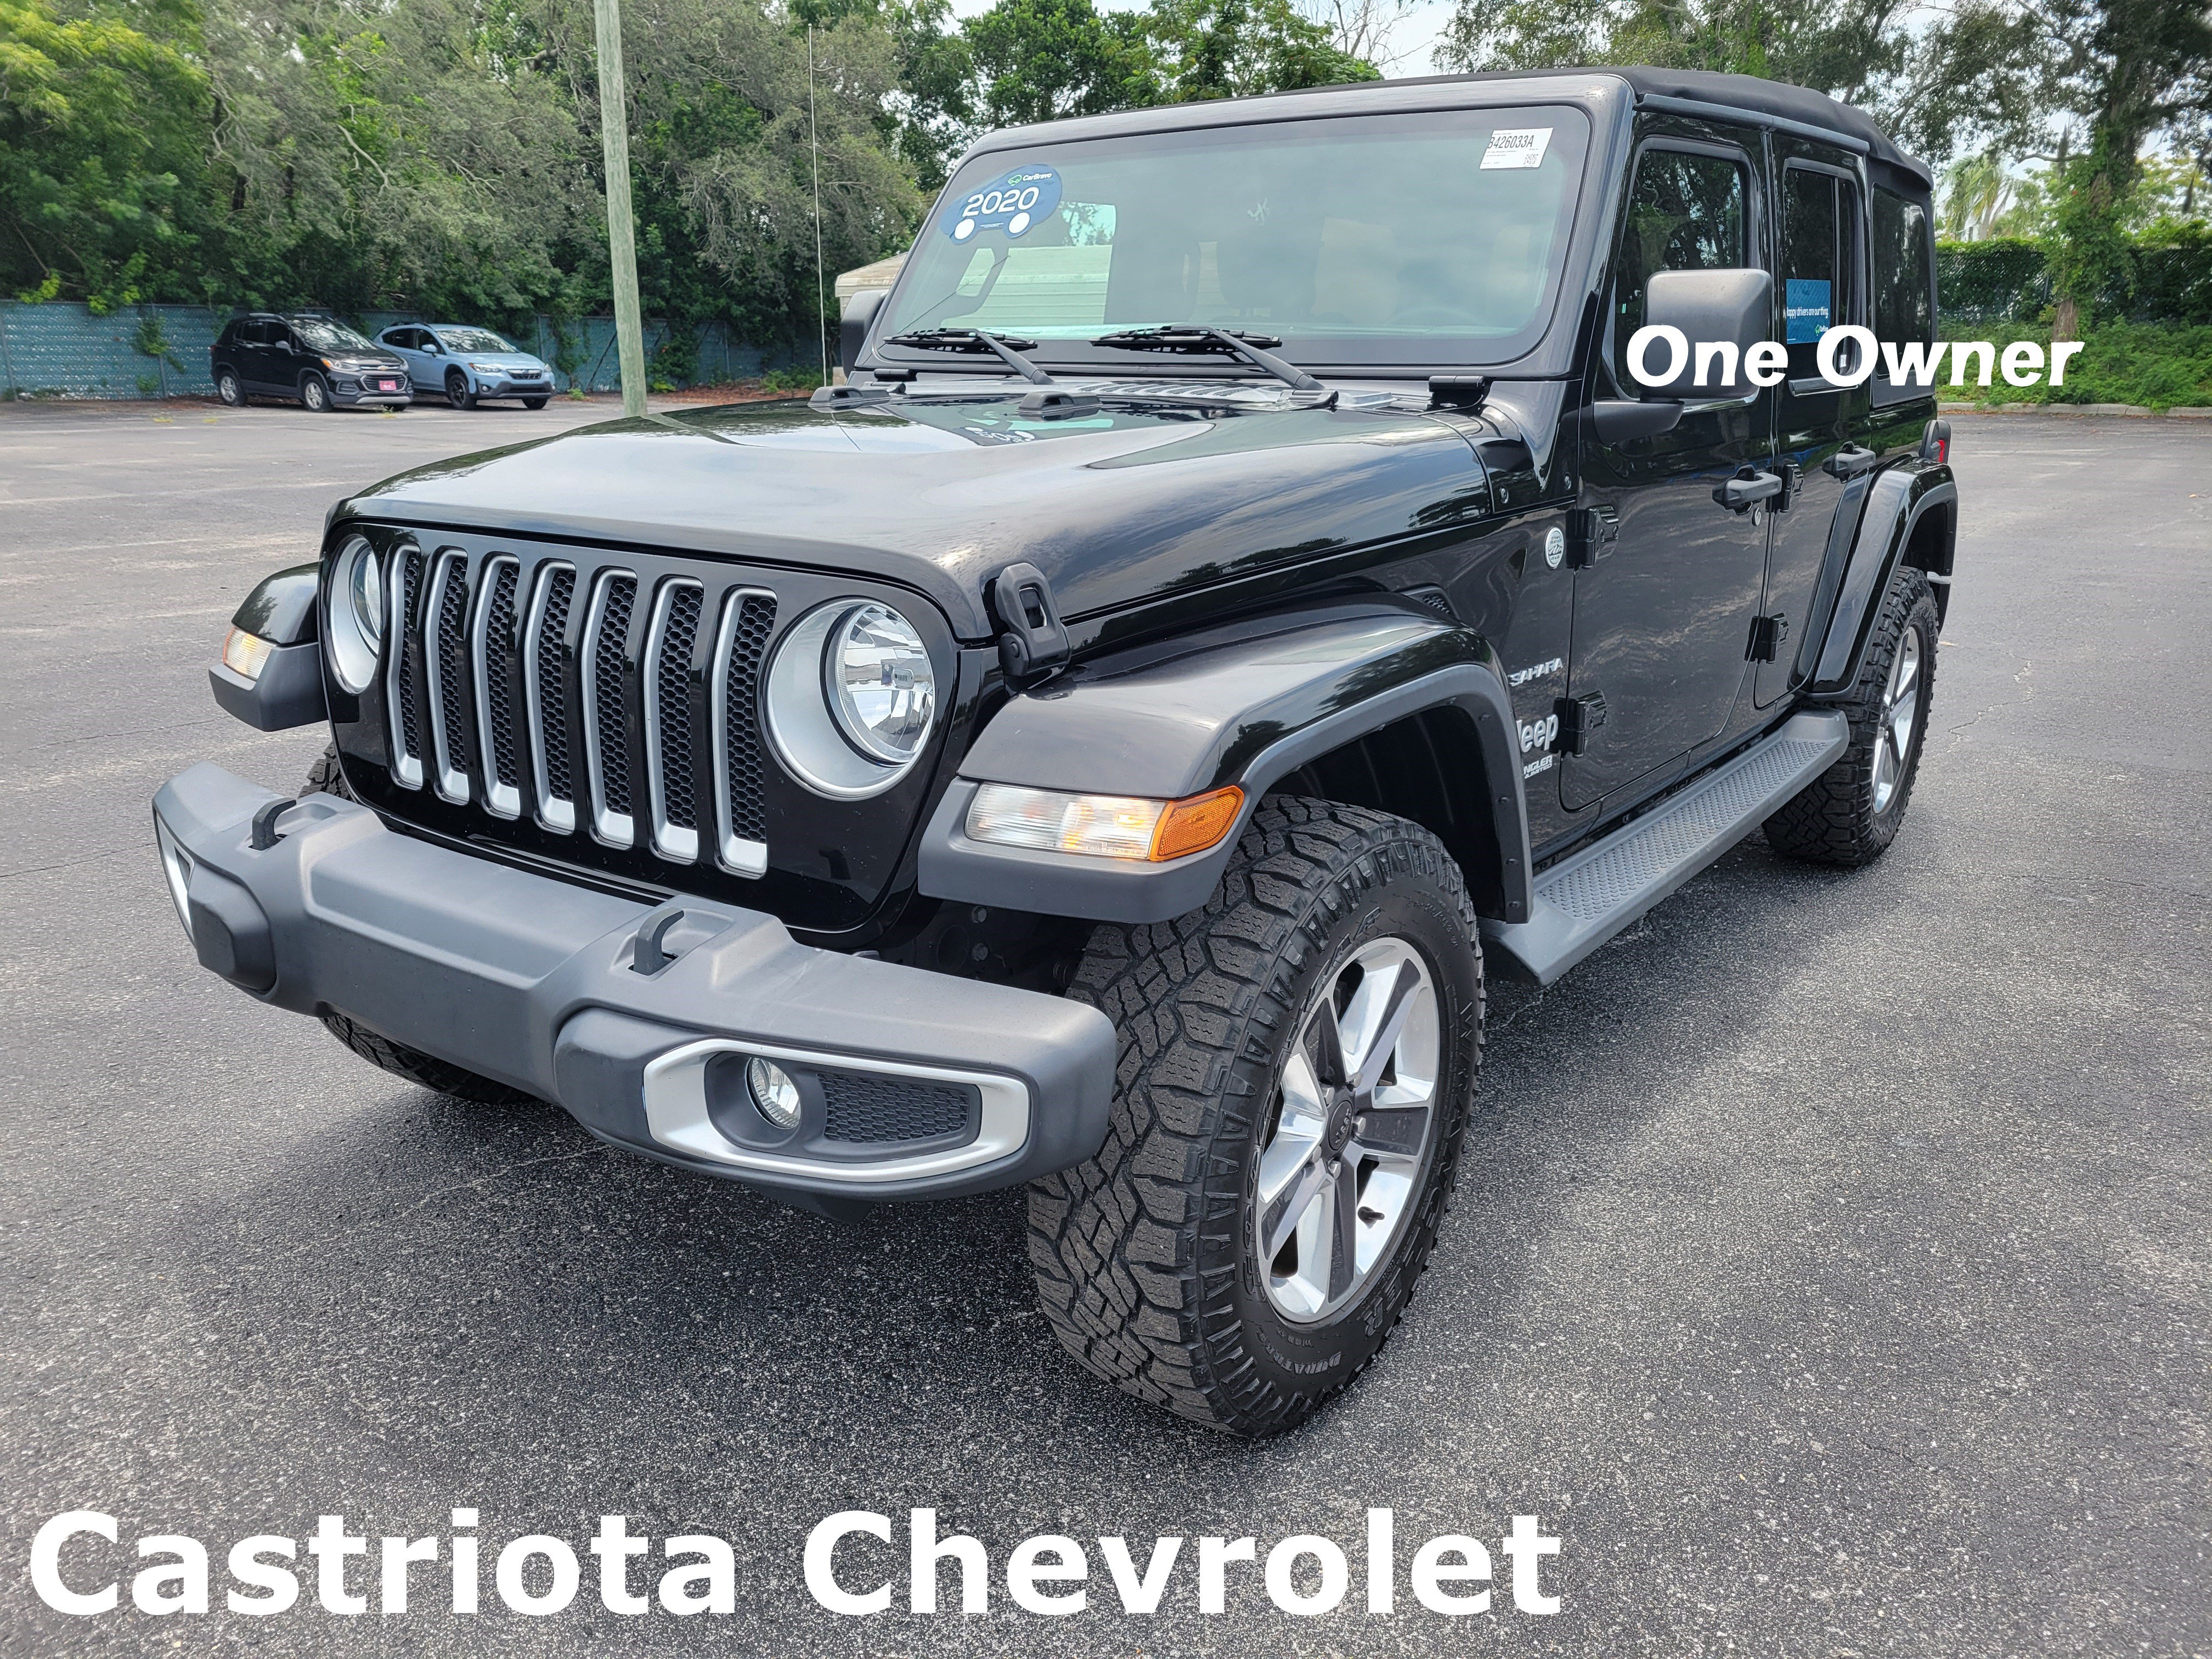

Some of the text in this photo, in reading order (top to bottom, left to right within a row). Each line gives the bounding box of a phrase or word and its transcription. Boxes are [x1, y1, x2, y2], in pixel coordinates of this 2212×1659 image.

[1022, 173, 1052, 182] CarBravo
[962, 187, 1040, 217] 2020
[1797, 306, 1809, 317] drivers
[1507, 658, 1563, 687] SAHARA
[1523, 754, 1553, 775] NGLER
